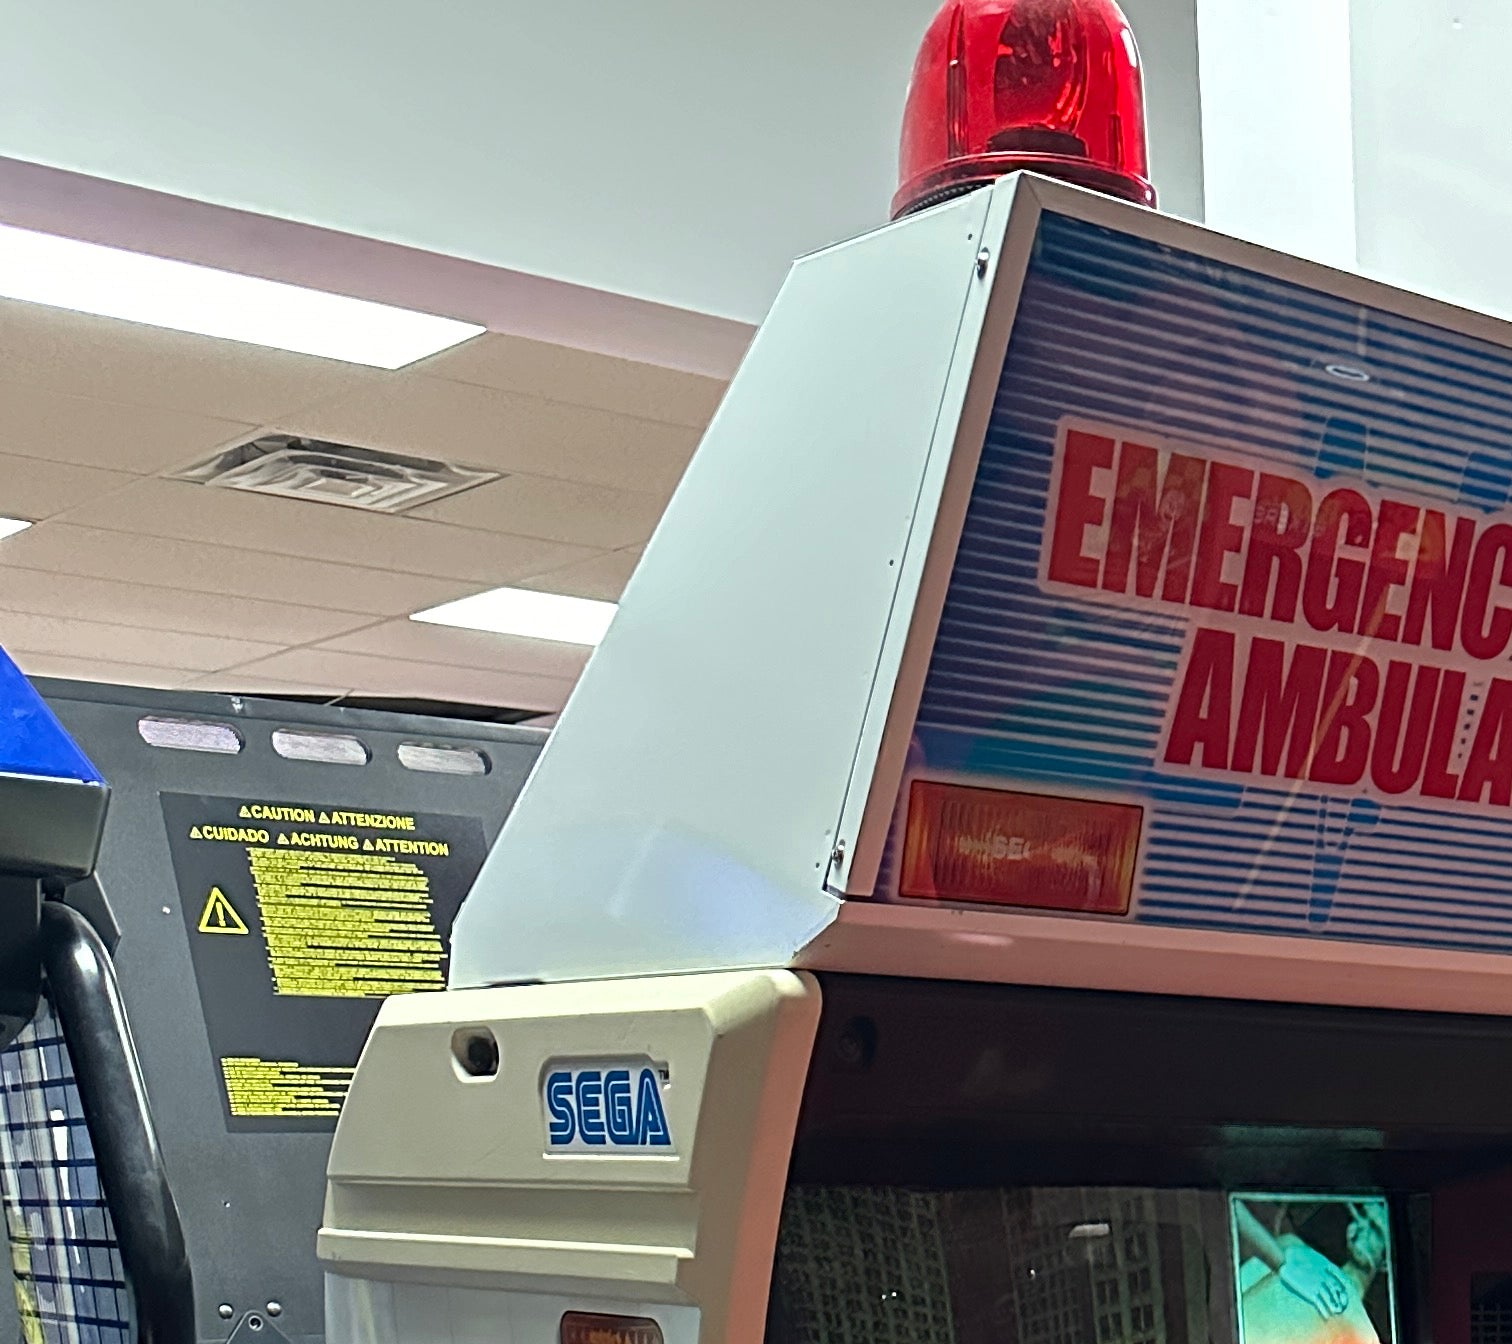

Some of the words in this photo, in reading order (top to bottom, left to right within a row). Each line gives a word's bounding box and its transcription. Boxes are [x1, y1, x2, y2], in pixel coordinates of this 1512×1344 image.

[251, 806, 315, 824] CAUTION
[332, 811, 415, 831] ATTENZIONE
[202, 826, 269, 844] CUIDADO
[291, 833, 359, 851] ACHTUNG
[375, 838, 449, 857] ATTENTION
[546, 1067, 672, 1146] SEGA
